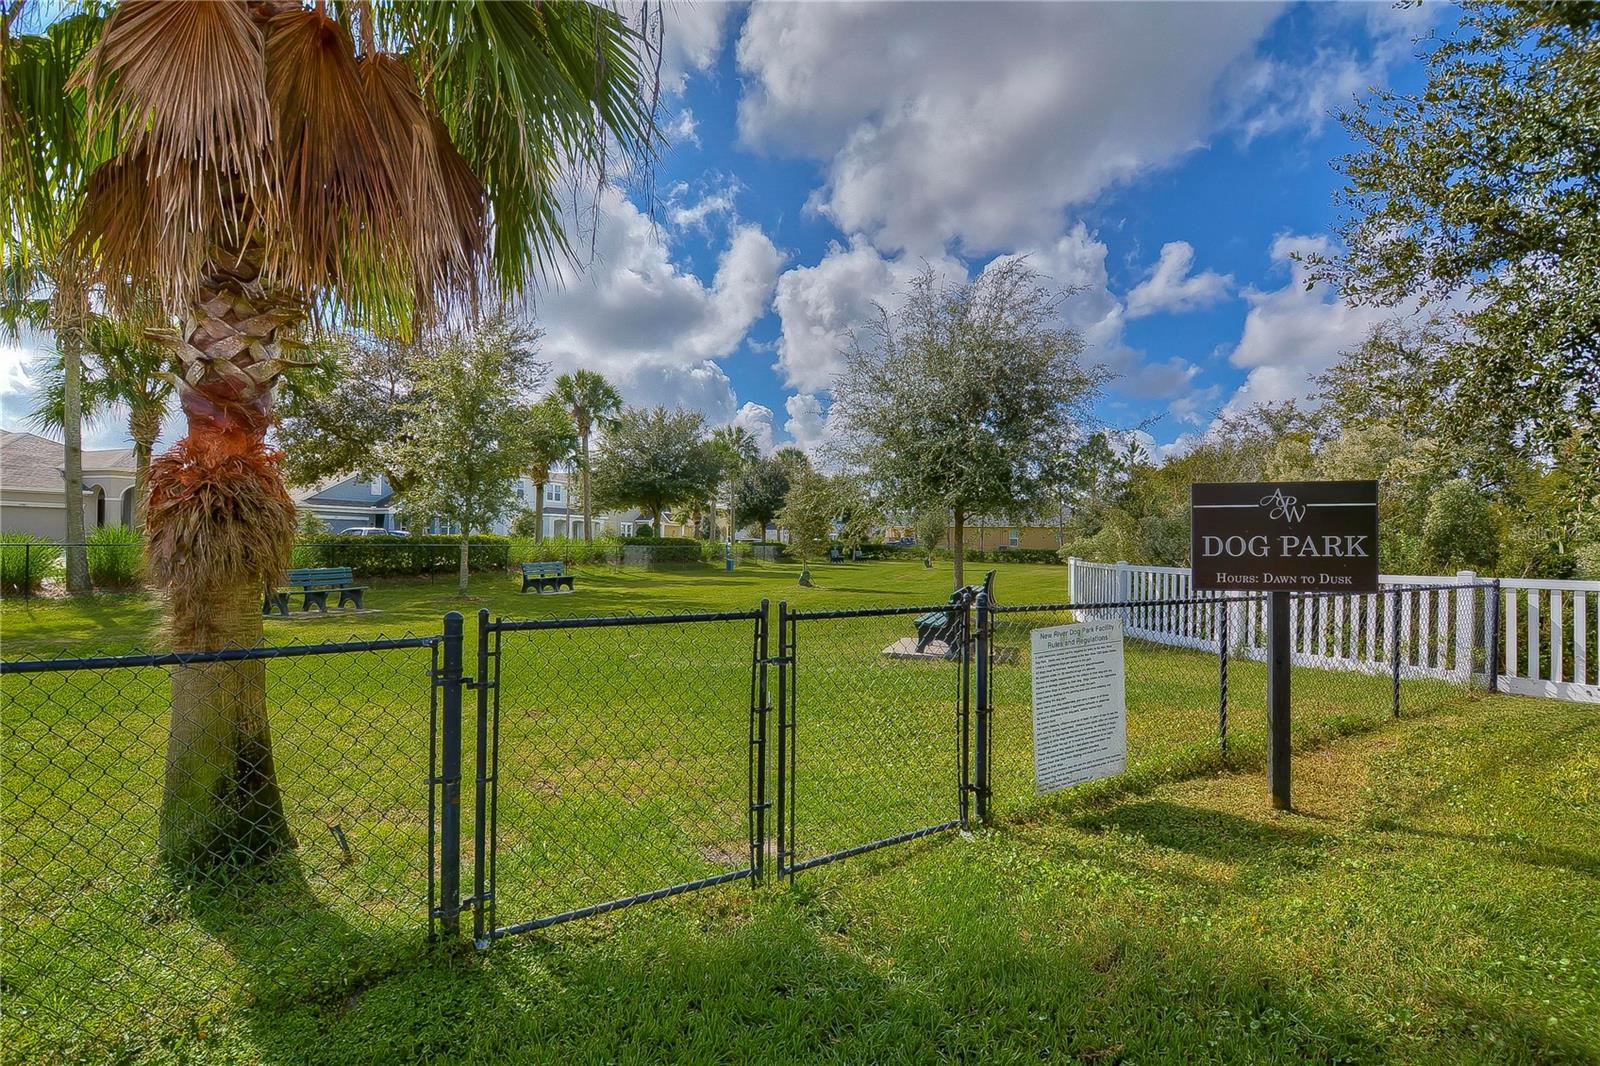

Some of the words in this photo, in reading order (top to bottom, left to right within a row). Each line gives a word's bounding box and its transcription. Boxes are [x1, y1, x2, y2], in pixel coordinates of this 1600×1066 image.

[1202, 535, 1271, 557] DOG
[1280, 535, 1368, 557] PARK
[1263, 573, 1297, 584] DAWN
[1319, 573, 1352, 585] DUSK
[1053, 630, 1068, 638] River
[1069, 628, 1080, 636] Dog
[1082, 626, 1094, 634] Park
[1095, 624, 1114, 632] Facility
[1047, 641, 1063, 649] Rules
[1065, 639, 1075, 647] and
[1076, 635, 1108, 646] Regulations
